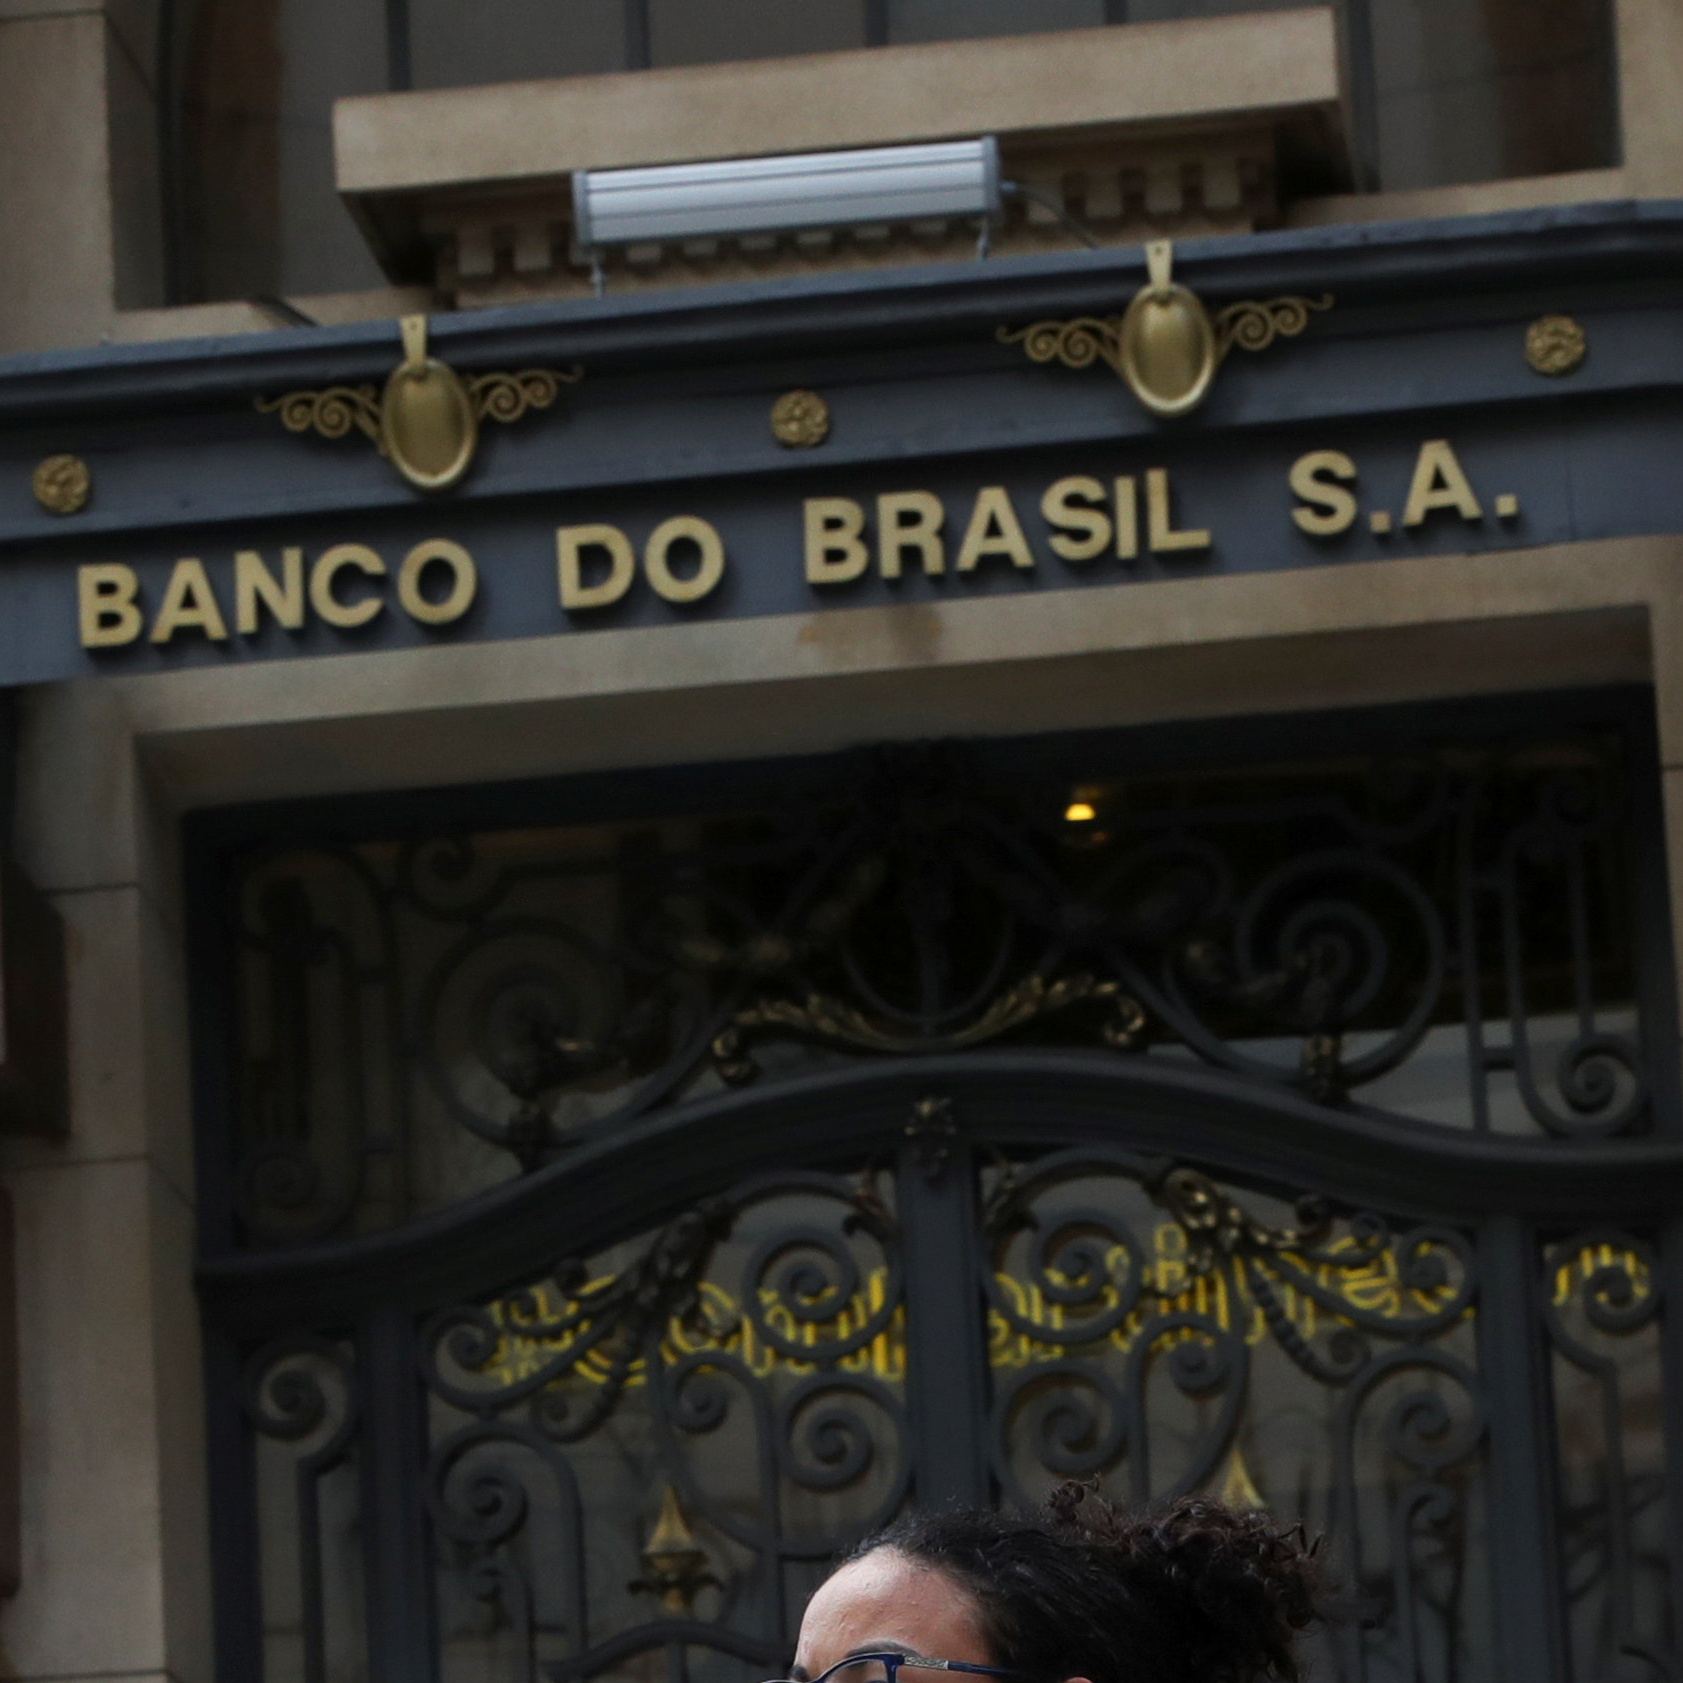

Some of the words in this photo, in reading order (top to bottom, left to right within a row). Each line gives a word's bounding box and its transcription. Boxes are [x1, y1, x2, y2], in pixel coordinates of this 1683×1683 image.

[76, 536, 478, 648] BANCO
[555, 514, 725, 609] DO
[803, 469, 1212, 584] BRASIL
[1288, 439, 1518, 535] S.A.
